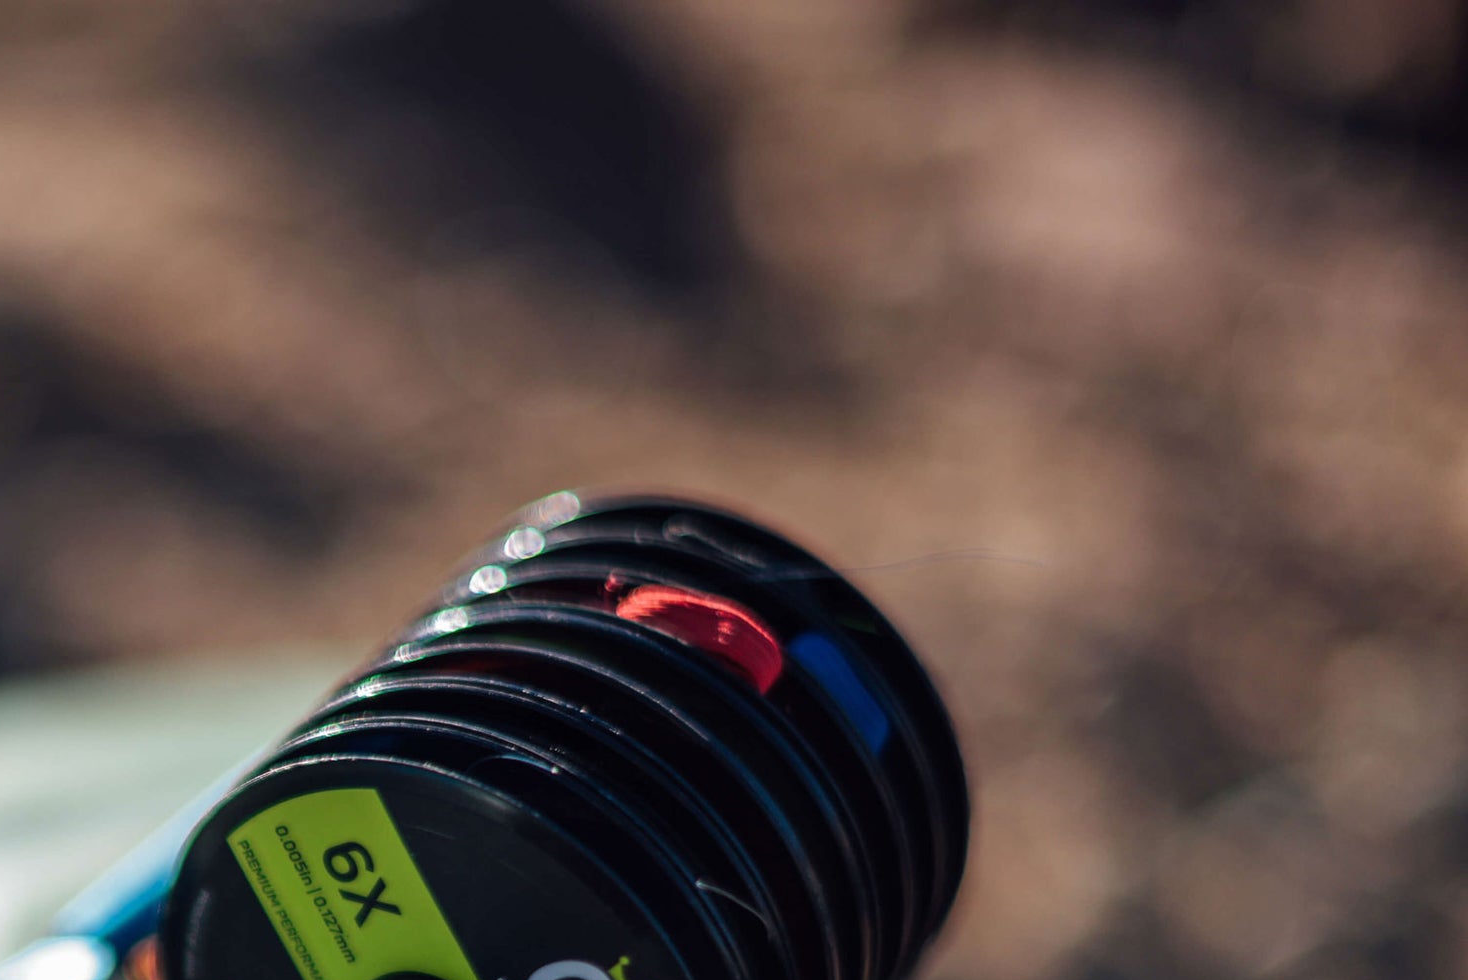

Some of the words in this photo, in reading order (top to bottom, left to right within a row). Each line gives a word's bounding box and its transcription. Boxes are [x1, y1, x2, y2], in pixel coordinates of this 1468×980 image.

[237, 839, 281, 908] PREMIUM
[275, 825, 312, 887] 0.005in
[313, 896, 355, 964] 0.127mm
[322, 840, 402, 929] 6X
